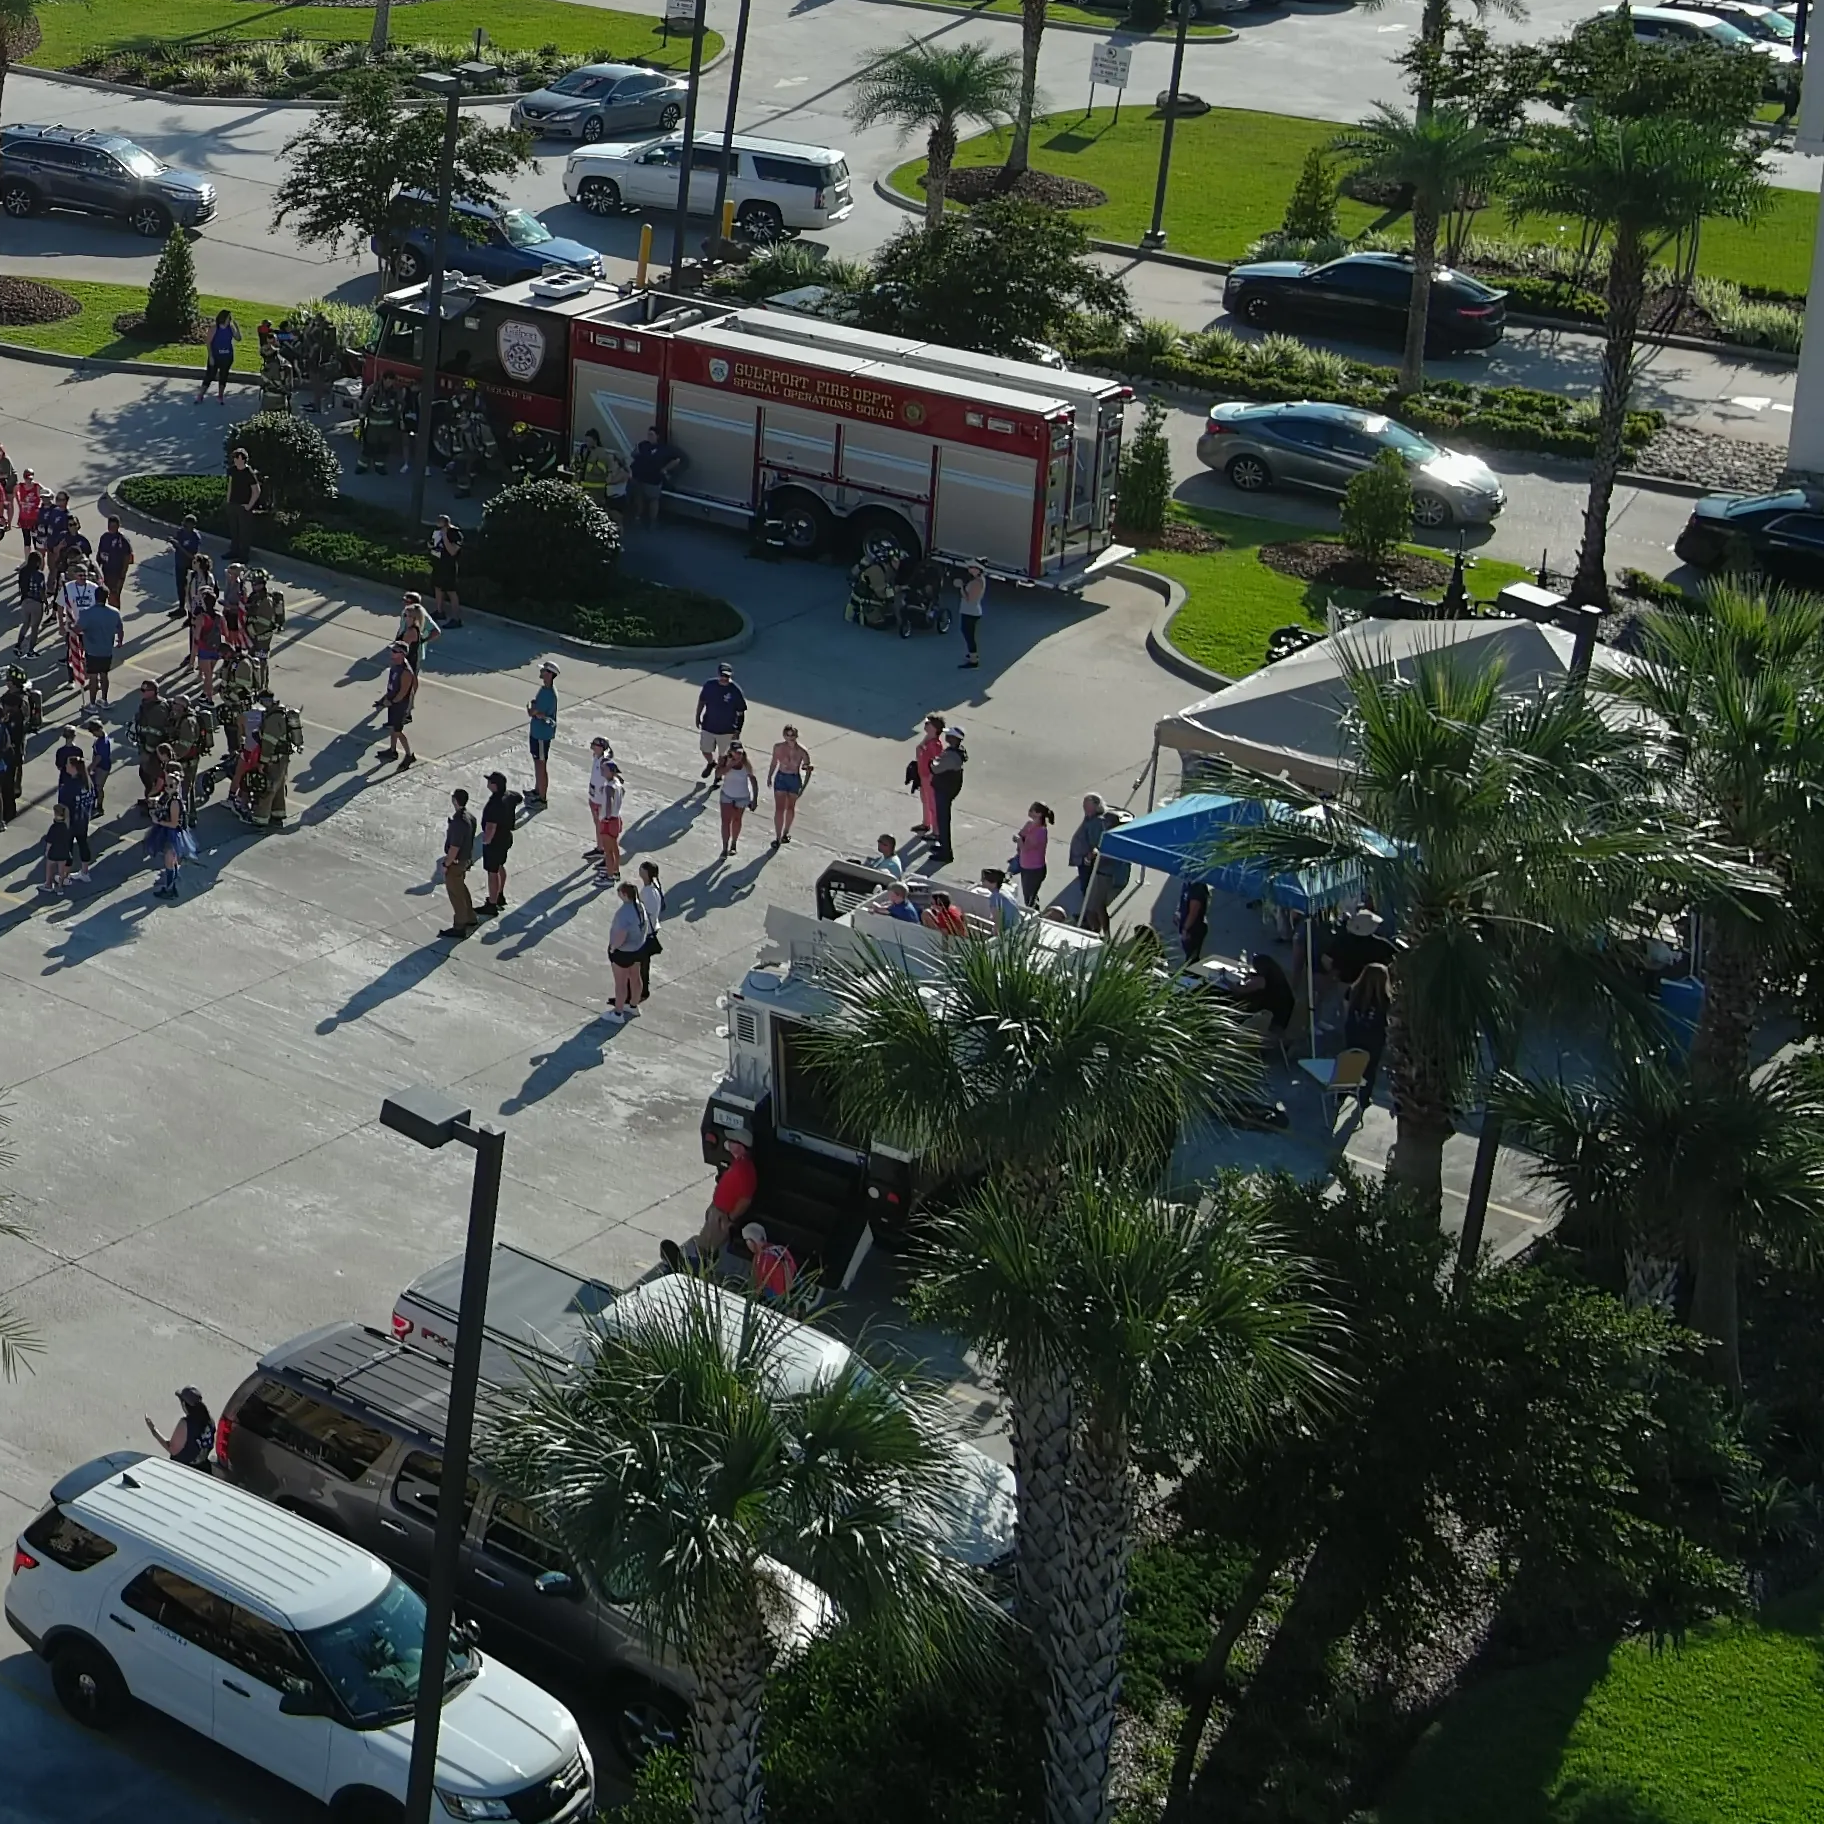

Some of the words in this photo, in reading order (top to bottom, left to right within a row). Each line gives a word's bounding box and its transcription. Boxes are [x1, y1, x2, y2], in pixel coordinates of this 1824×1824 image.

[733, 377, 780, 395] SPECIAL
[783, 388, 853, 412] OPERATIONS
[856, 404, 894, 420] SQUAD
[734, 362, 810, 389] GULFPORT
[816, 380, 850, 399] FIRE
[853, 388, 896, 409] DEPT.
